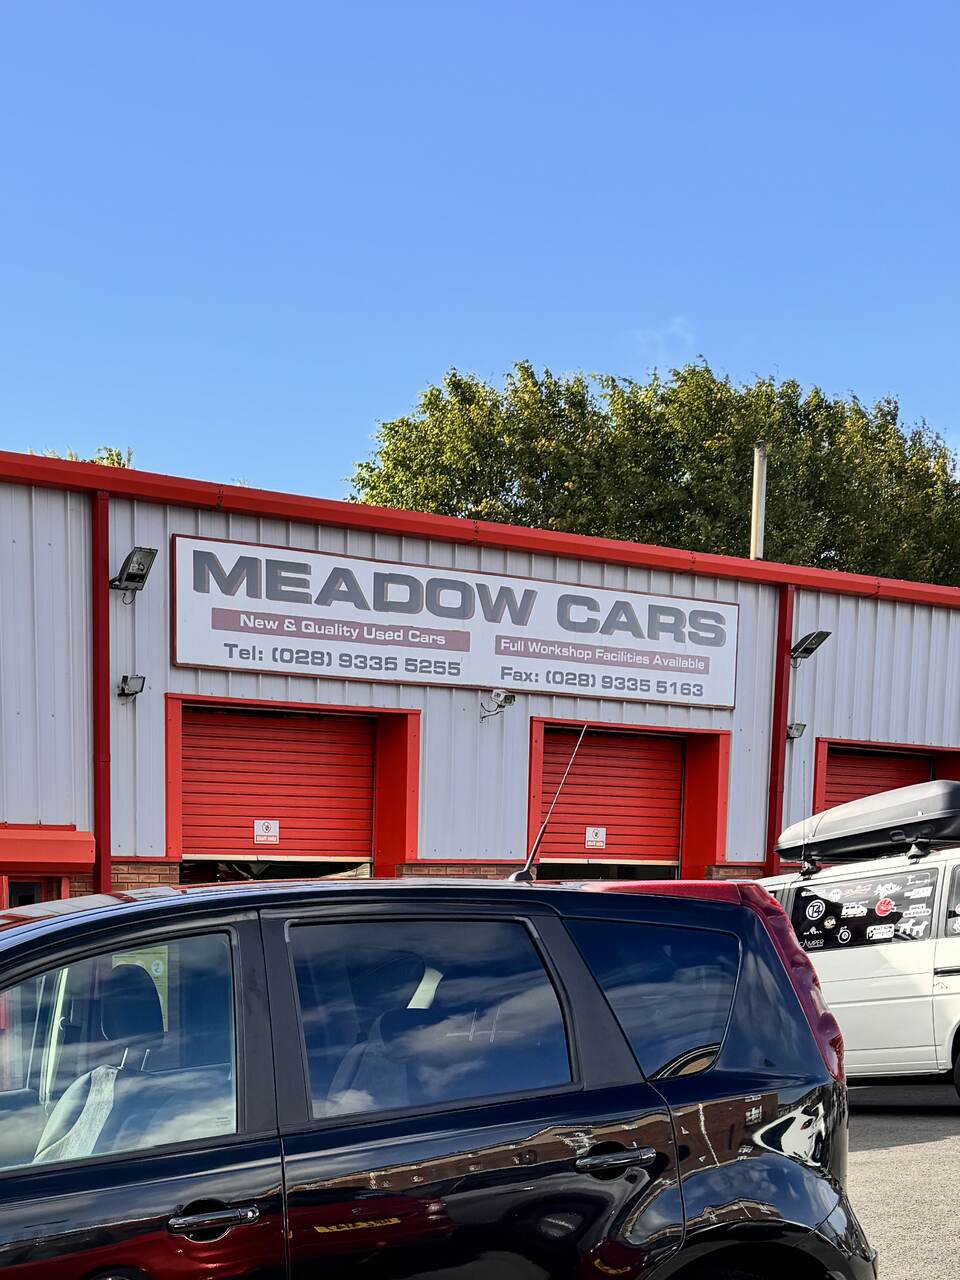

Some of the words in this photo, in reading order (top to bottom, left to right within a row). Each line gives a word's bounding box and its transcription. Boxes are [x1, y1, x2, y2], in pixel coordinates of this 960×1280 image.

[193, 550, 538, 626] MEADOW
[556, 594, 727, 648] CARS
[240, 614, 279, 630] New
[283, 618, 297, 632] &
[301, 620, 360, 640] Quality
[363, 626, 404, 642] Used
[408, 630, 446, 645] Cars
[223, 642, 264, 662] Tel:
[271, 647, 332, 667] (028)
[339, 652, 398, 671] 9335
[404, 657, 461, 677] 5255
[500, 638, 525, 652] Full
[528, 641, 592, 660] Workshop
[595, 649, 650, 665] Facilities
[652, 654, 705, 670] Available
[500, 666, 539, 683] Fax:
[545, 670, 596, 687] (028)
[601, 675, 650, 693] 9335
[656, 680, 704, 697] 5163
